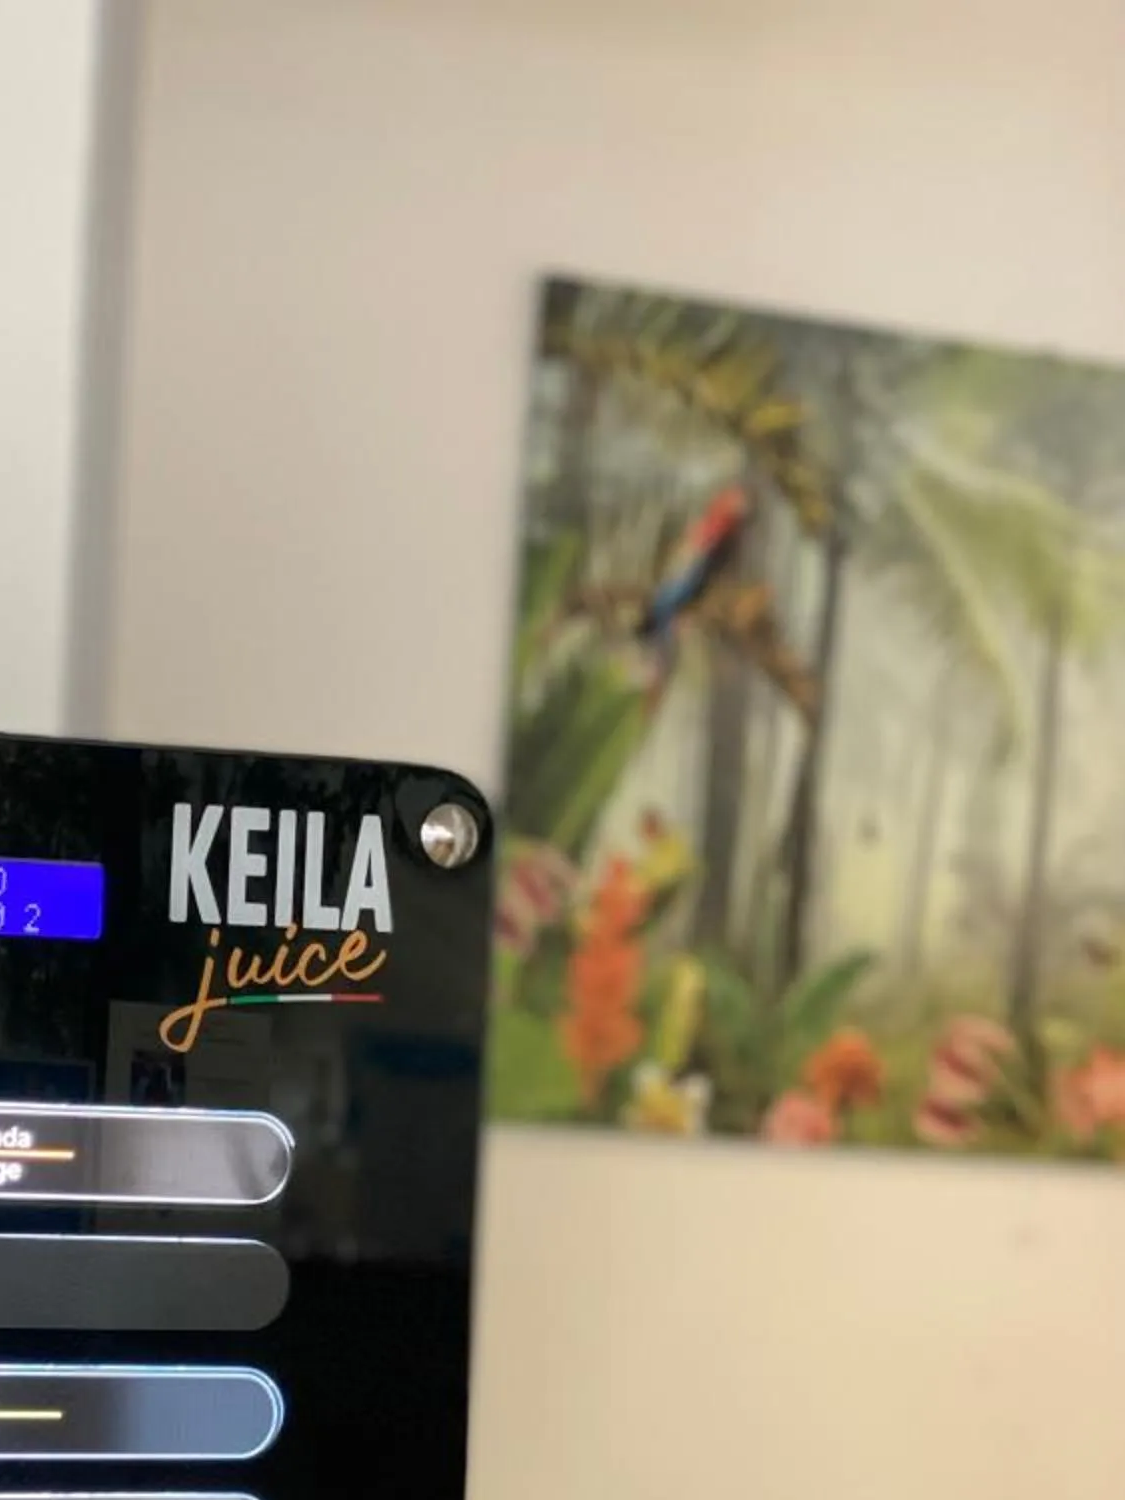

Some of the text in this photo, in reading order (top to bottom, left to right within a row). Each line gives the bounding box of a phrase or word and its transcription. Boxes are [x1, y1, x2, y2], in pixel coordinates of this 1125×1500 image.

[23, 903, 42, 933] 2
[169, 803, 394, 933] KEILA
[159, 925, 387, 1052] juice
